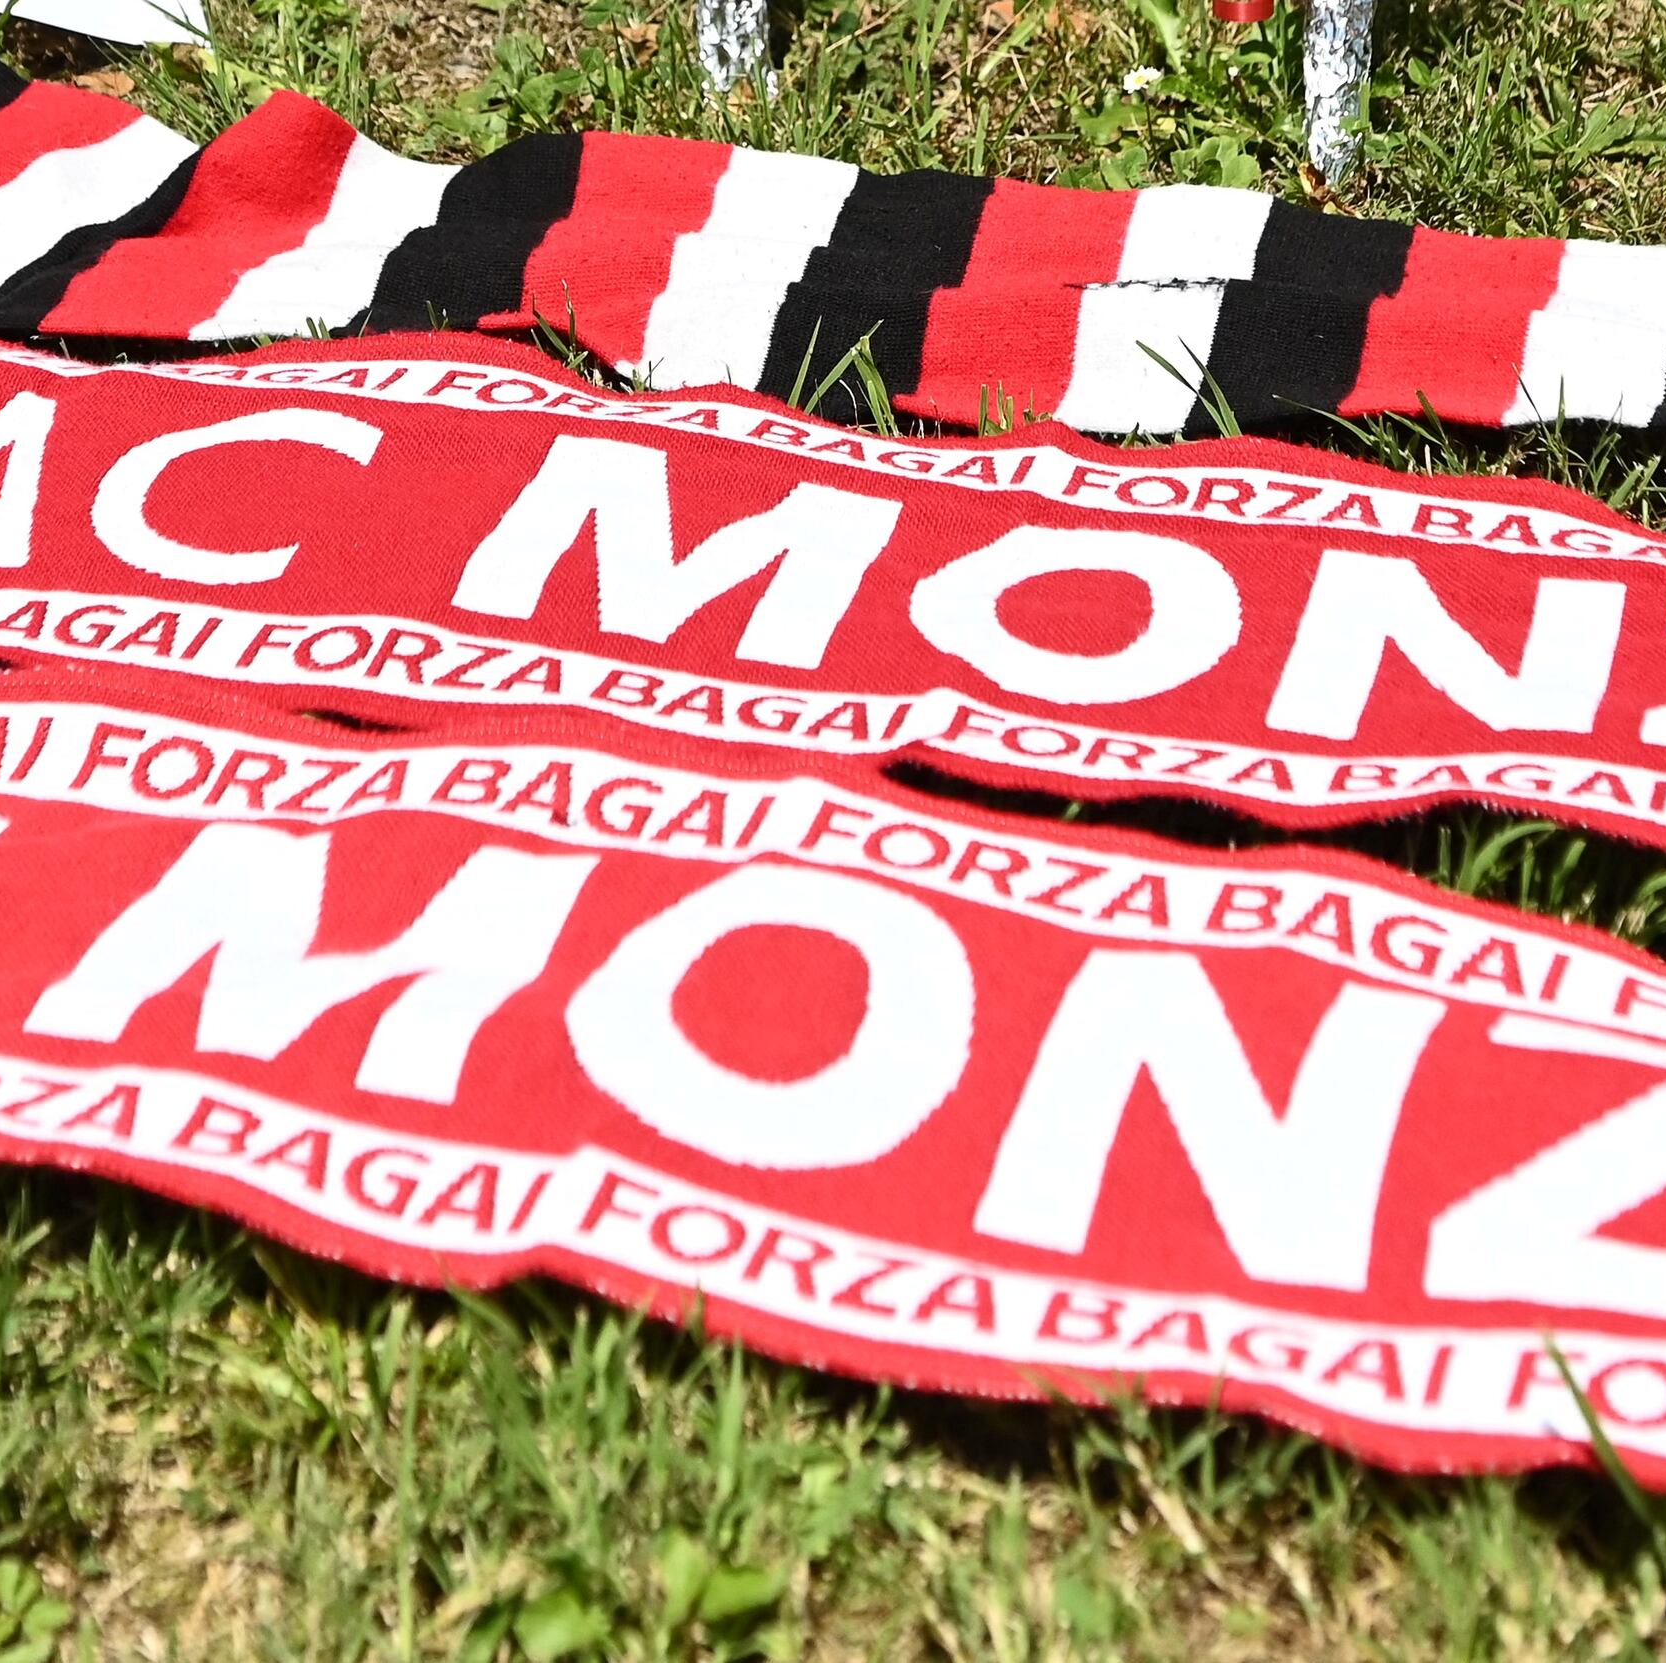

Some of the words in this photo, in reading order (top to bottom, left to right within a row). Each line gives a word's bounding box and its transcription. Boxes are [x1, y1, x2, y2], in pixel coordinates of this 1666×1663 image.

[158, 366, 409, 392] AGAI
[425, 370, 721, 432] FORZA
[745, 416, 1037, 485] BAGAI
[1062, 464, 1382, 529] FORZA
[235, 622, 563, 694] FORZA
[589, 668, 914, 742] BAGAI
[941, 704, 1295, 793] FORZA
[69, 722, 411, 814] FORZA
[429, 757, 777, 849] BAGAI
[798, 799, 1172, 930] FORZA
[1204, 883, 1571, 1003] BAGAI
[170, 1094, 553, 1236] BAGAI
[577, 1170, 999, 1334] FORZA
[1035, 1289, 1456, 1409] BAGAI
